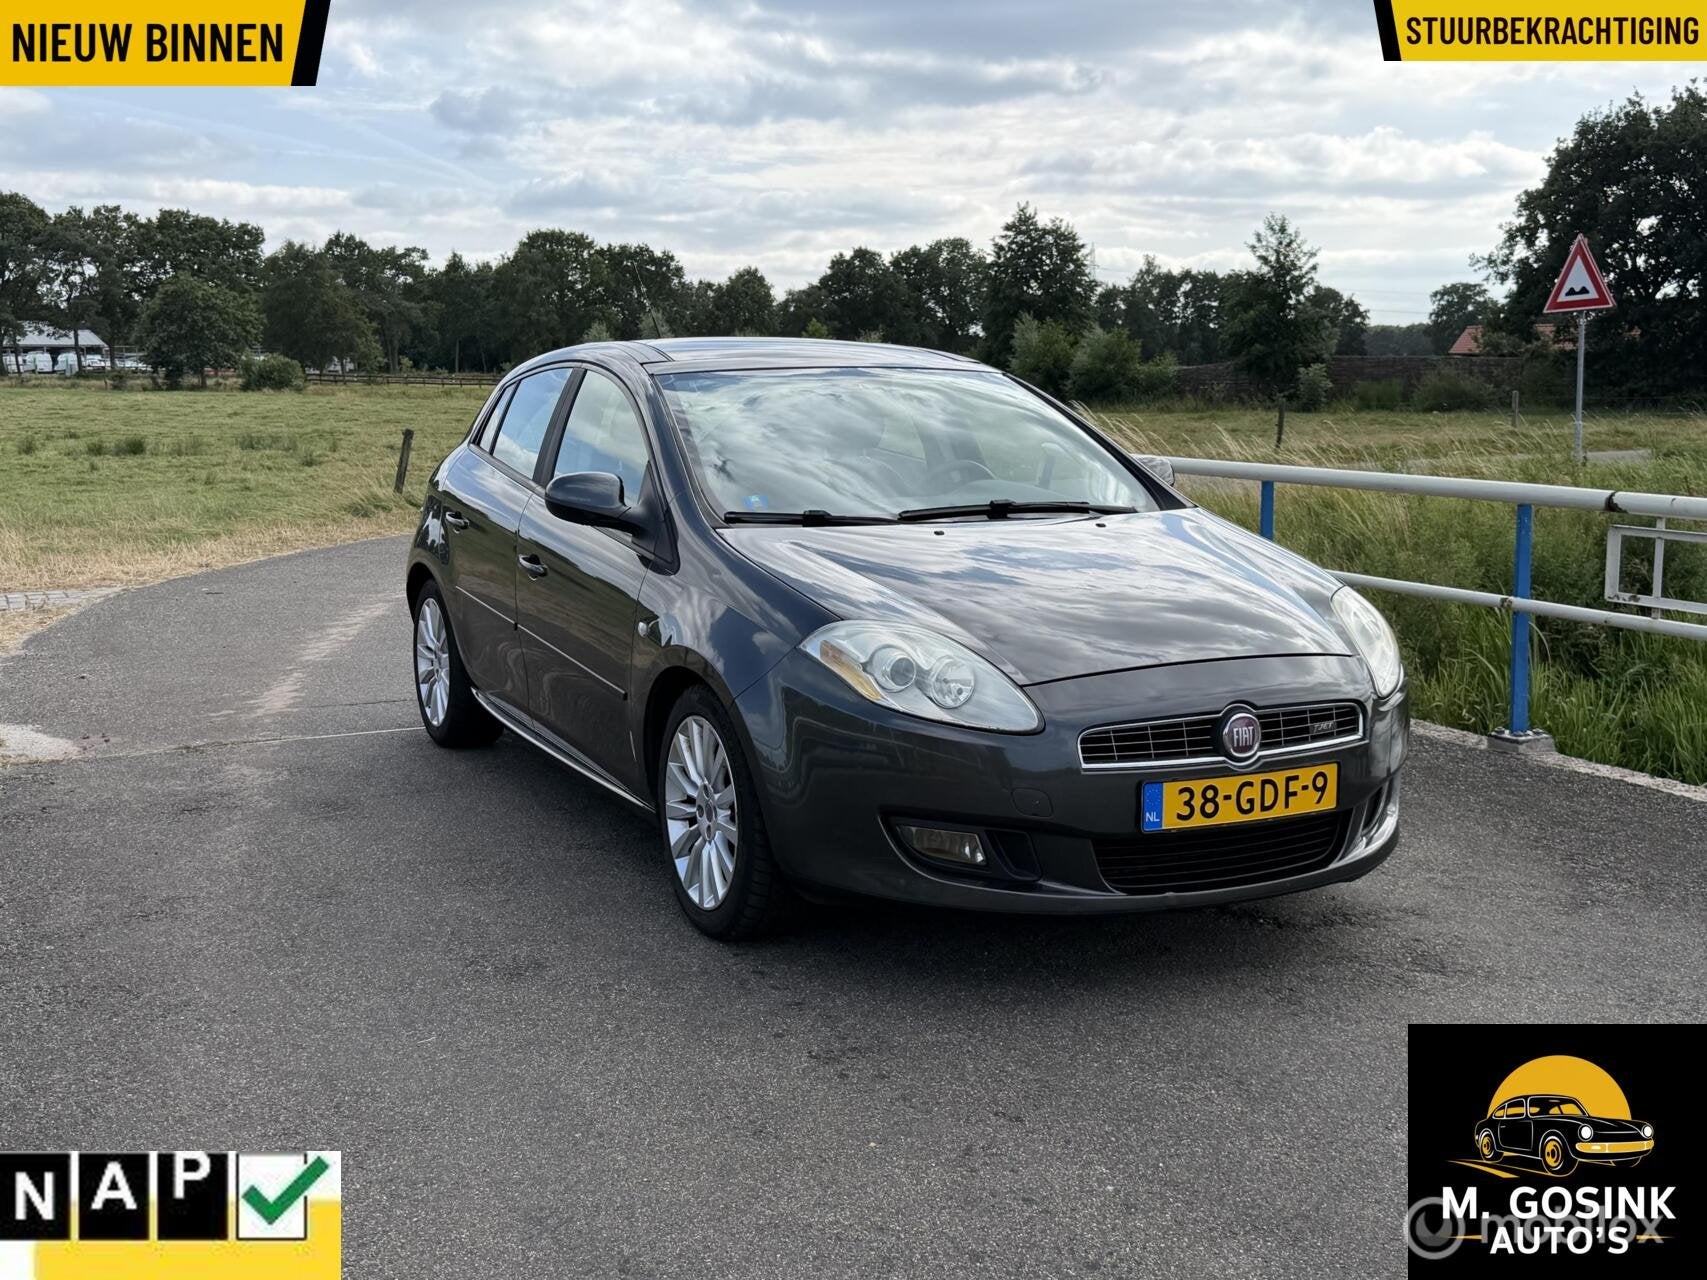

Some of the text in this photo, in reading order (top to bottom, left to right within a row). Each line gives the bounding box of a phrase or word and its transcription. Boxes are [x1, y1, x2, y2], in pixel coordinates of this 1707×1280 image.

[1233, 725, 1255, 748] FIAT
[1176, 771, 1328, 821] 38-GDF-9
[1145, 811, 1160, 823] NL
